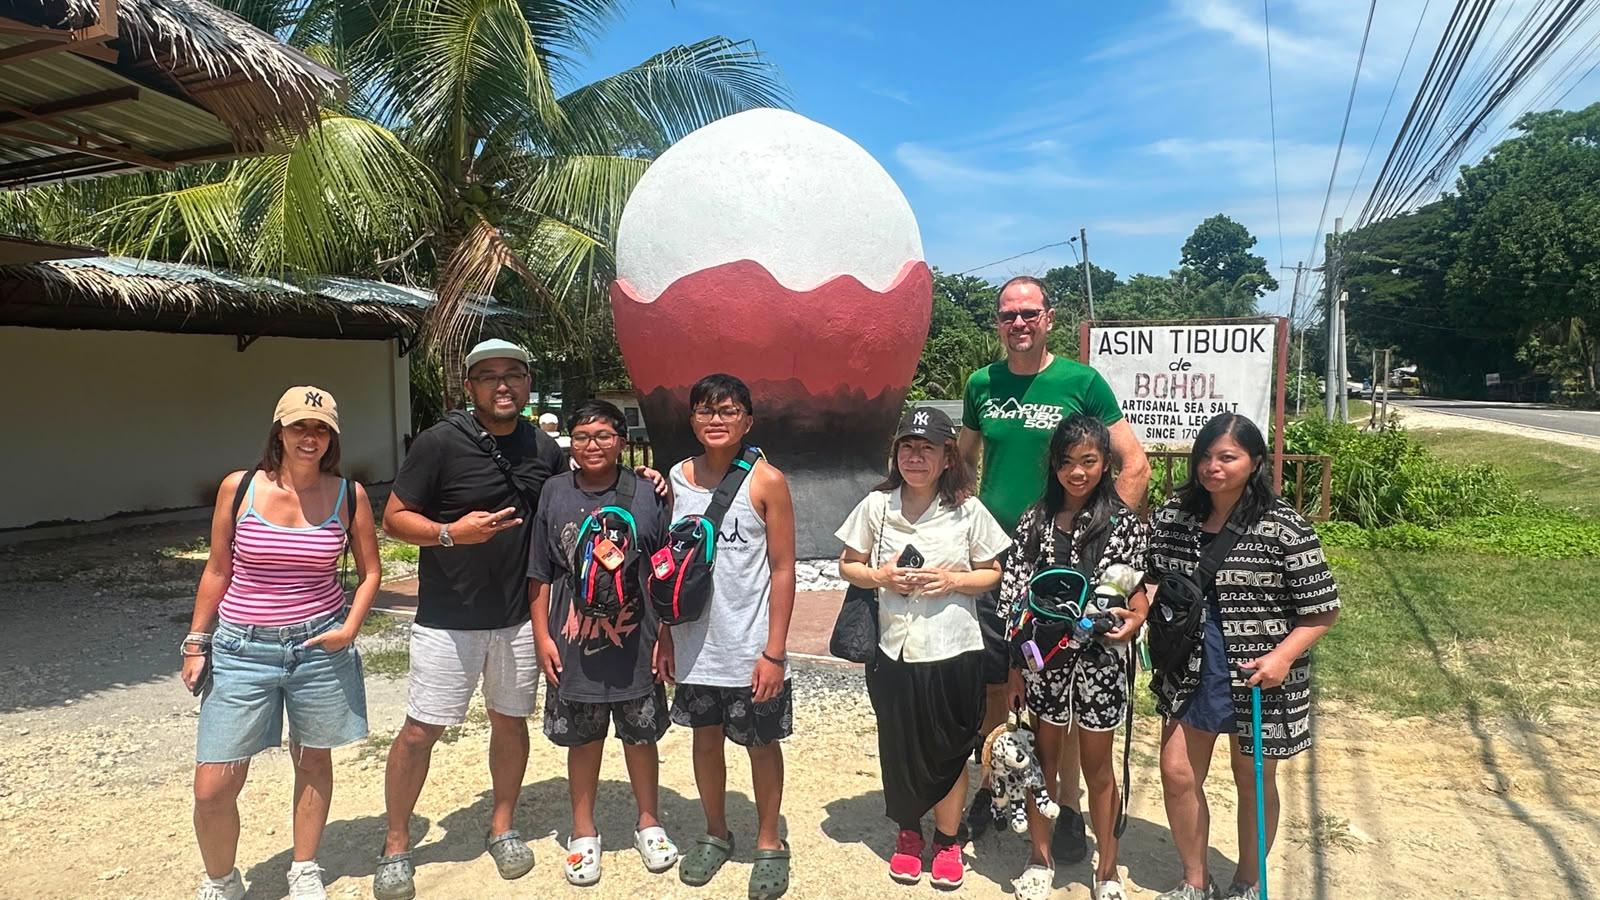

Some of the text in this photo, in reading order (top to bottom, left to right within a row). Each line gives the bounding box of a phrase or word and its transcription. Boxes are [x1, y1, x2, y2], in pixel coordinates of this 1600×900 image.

[1098, 327, 1266, 355] ASIN TIBUOK
[1168, 357, 1192, 372] de
[1134, 372, 1224, 400] BOHOL
[304, 391, 323, 408] NY
[1121, 400, 1239, 414] ARTISANAL SEA SALT
[912, 411, 930, 426] NY
[1123, 413, 1208, 427] ANCESTRAL LEG
[1145, 427, 1200, 440] SINCE 170
[715, 517, 748, 544] nd
